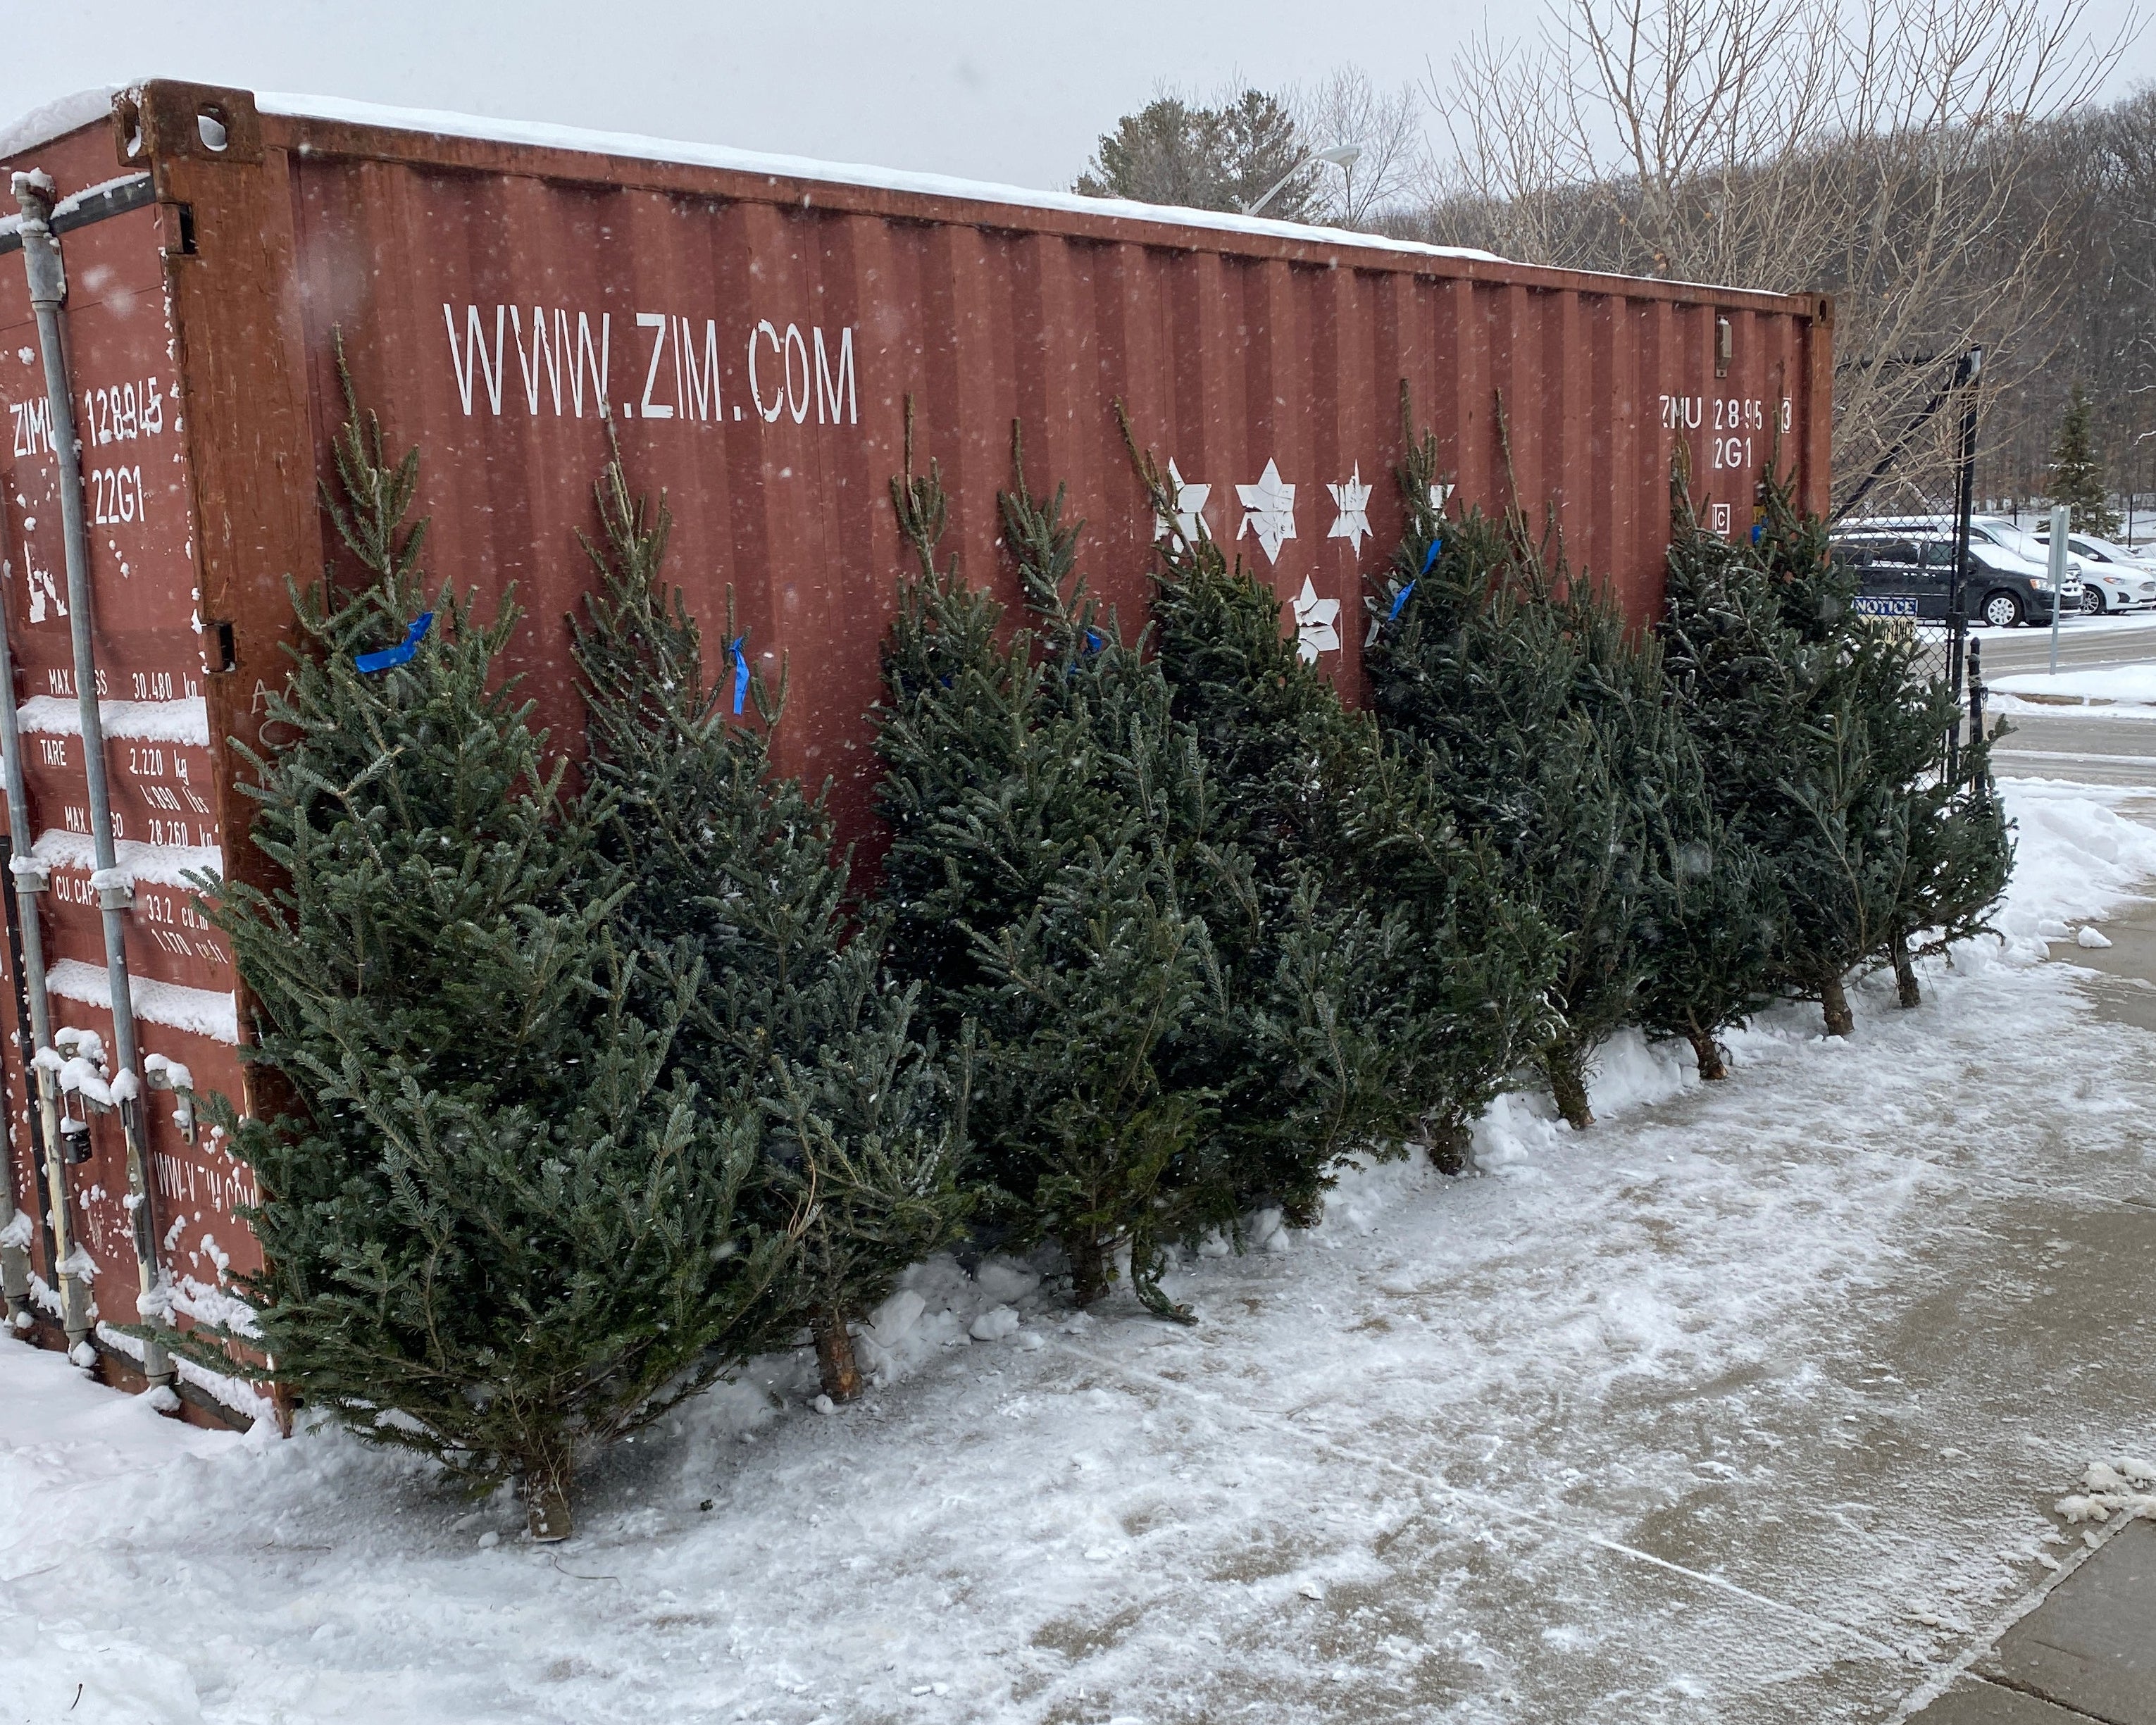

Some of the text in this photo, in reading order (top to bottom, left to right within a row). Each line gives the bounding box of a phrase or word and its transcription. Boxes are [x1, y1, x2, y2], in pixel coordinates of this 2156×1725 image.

[442, 303, 857, 425] WWW.ZIM.COM
[85, 376, 163, 447] 128945
[92, 465, 145, 525] 22G1
[1855, 599, 1915, 615] NOTICE
[132, 671, 173, 699] 30.480
[40, 740, 67, 766] TARE
[129, 748, 189, 786] 2.220 kg
[139, 784, 209, 814] 4.890 lbs
[148, 818, 189, 847] 28.260
[146, 893, 174, 924] 33.2
